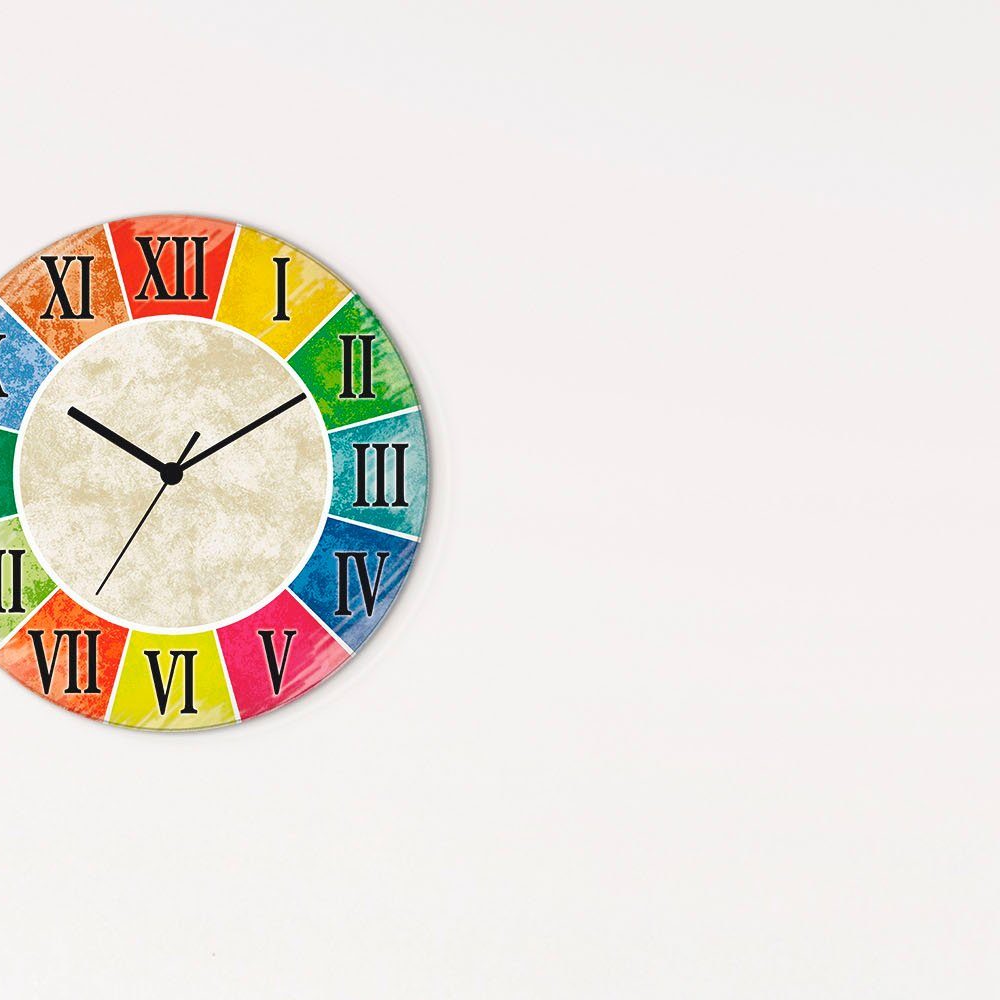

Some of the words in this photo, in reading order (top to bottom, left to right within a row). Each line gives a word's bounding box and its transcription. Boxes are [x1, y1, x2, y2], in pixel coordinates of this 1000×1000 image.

[40, 256, 94, 319] XI
[135, 237, 207, 299] XII
[273, 258, 289, 320] I
[339, 335, 375, 398] II
[353, 444, 408, 506] III
[335, 553, 389, 616] IV
[28, 631, 100, 694] VII
[144, 651, 197, 715] VI
[258, 631, 296, 694] V
